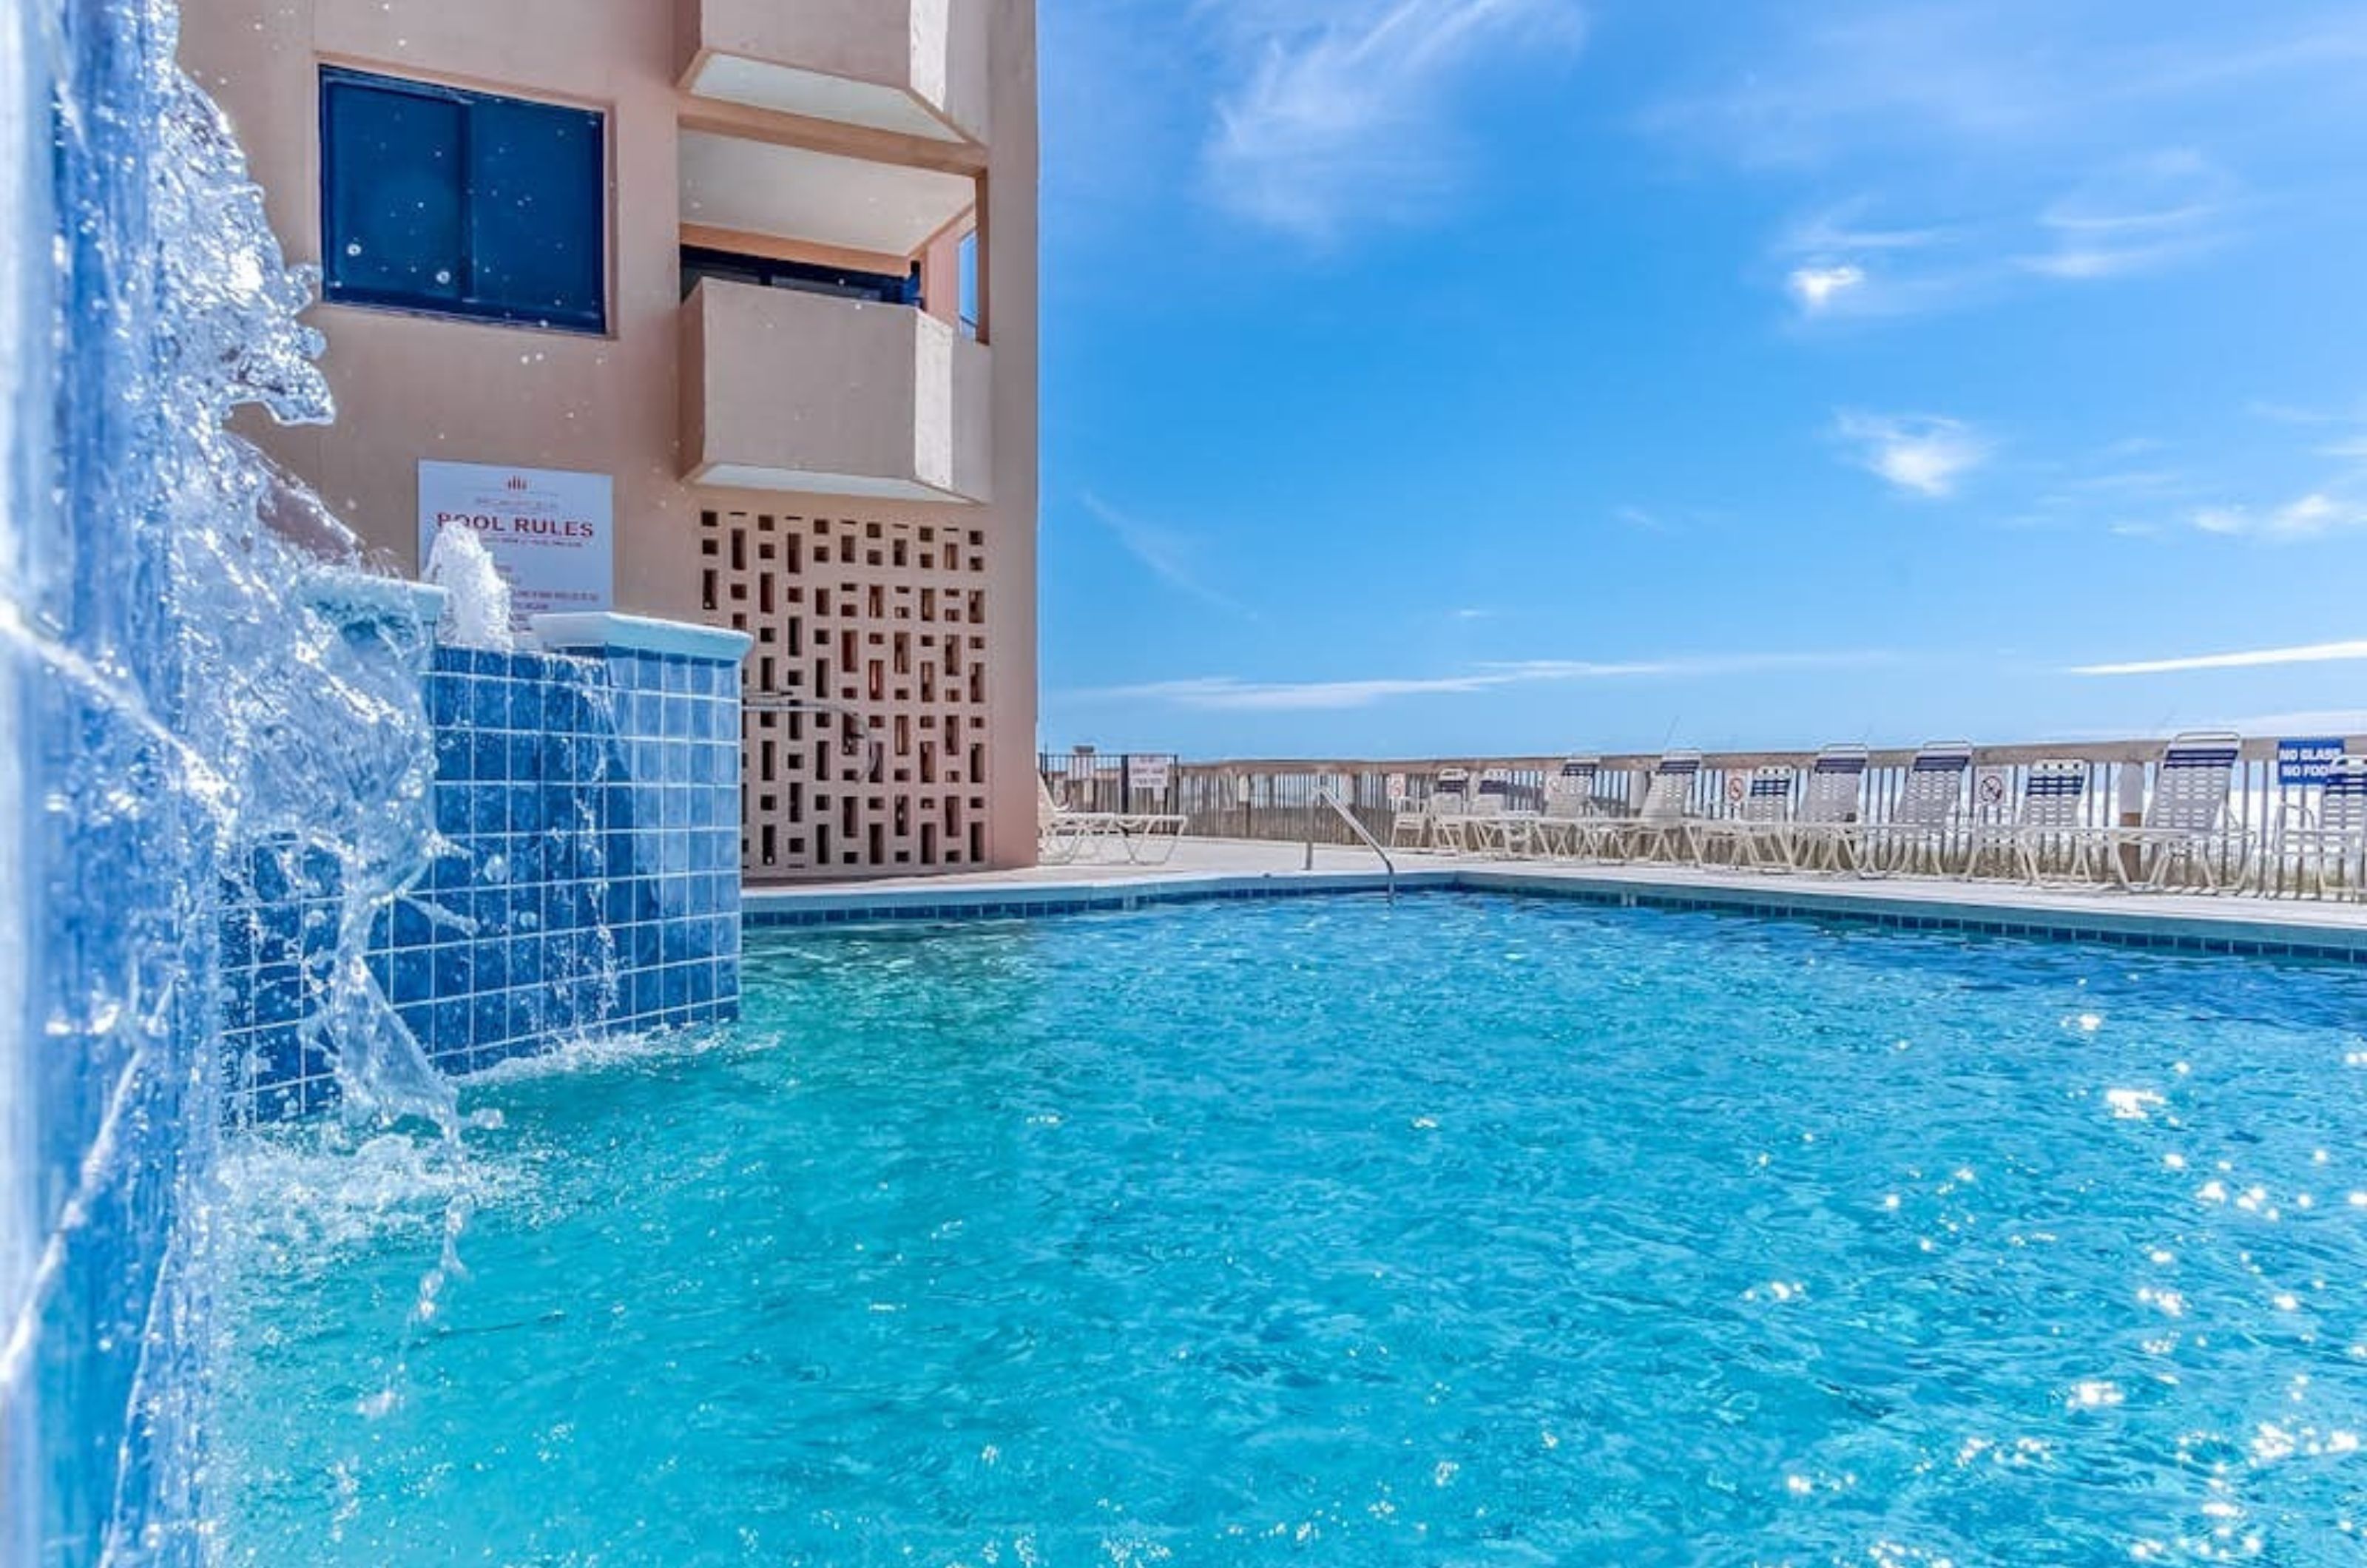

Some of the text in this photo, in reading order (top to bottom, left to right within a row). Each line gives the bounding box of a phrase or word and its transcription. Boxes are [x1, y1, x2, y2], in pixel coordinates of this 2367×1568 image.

[514, 516, 594, 537] RULES
[2279, 748, 2298, 761] NO
[2281, 763, 2330, 777] NO FOO
